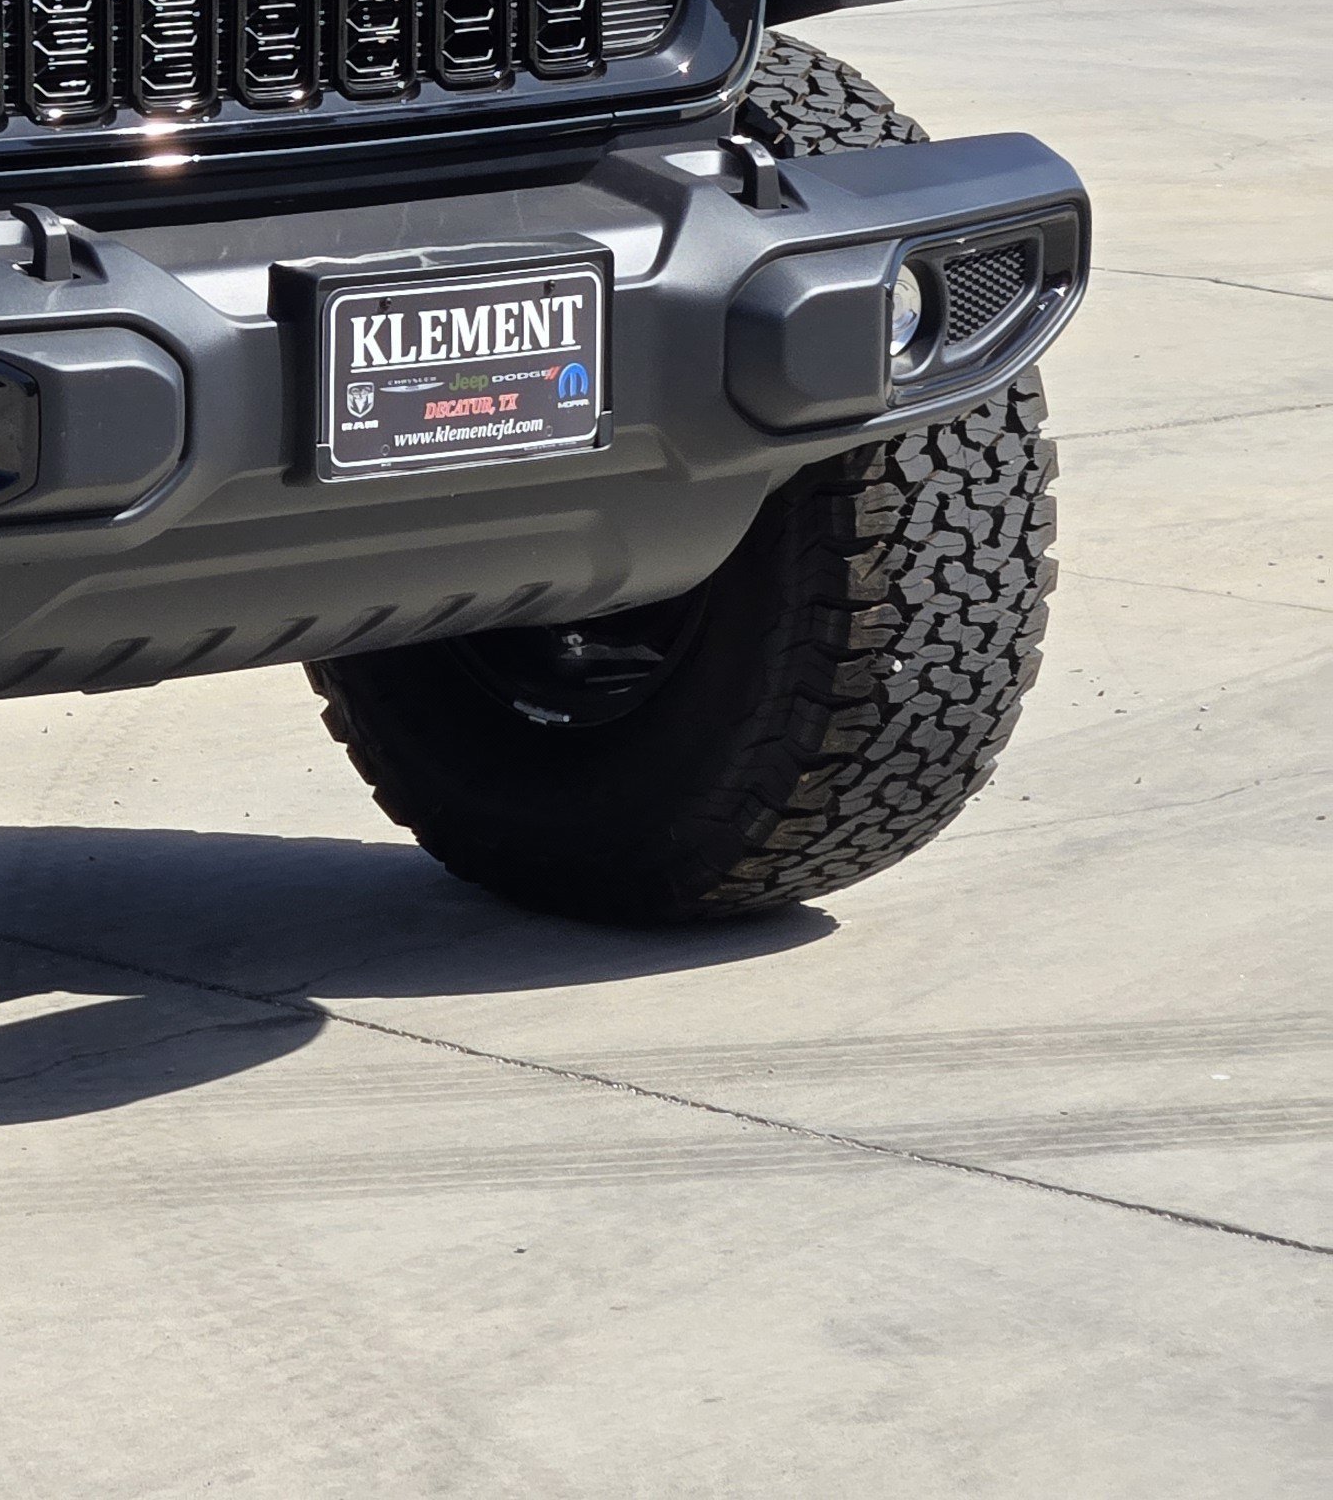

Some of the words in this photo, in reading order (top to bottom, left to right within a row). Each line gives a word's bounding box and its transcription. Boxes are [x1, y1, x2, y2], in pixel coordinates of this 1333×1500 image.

[350, 294, 583, 369] KLEMENT
[448, 372, 489, 392] Jeep
[491, 369, 551, 383] DODGE
[498, 392, 520, 412] TX
[341, 419, 379, 432] RAM
[394, 417, 544, 447] www.klementcjd.com
